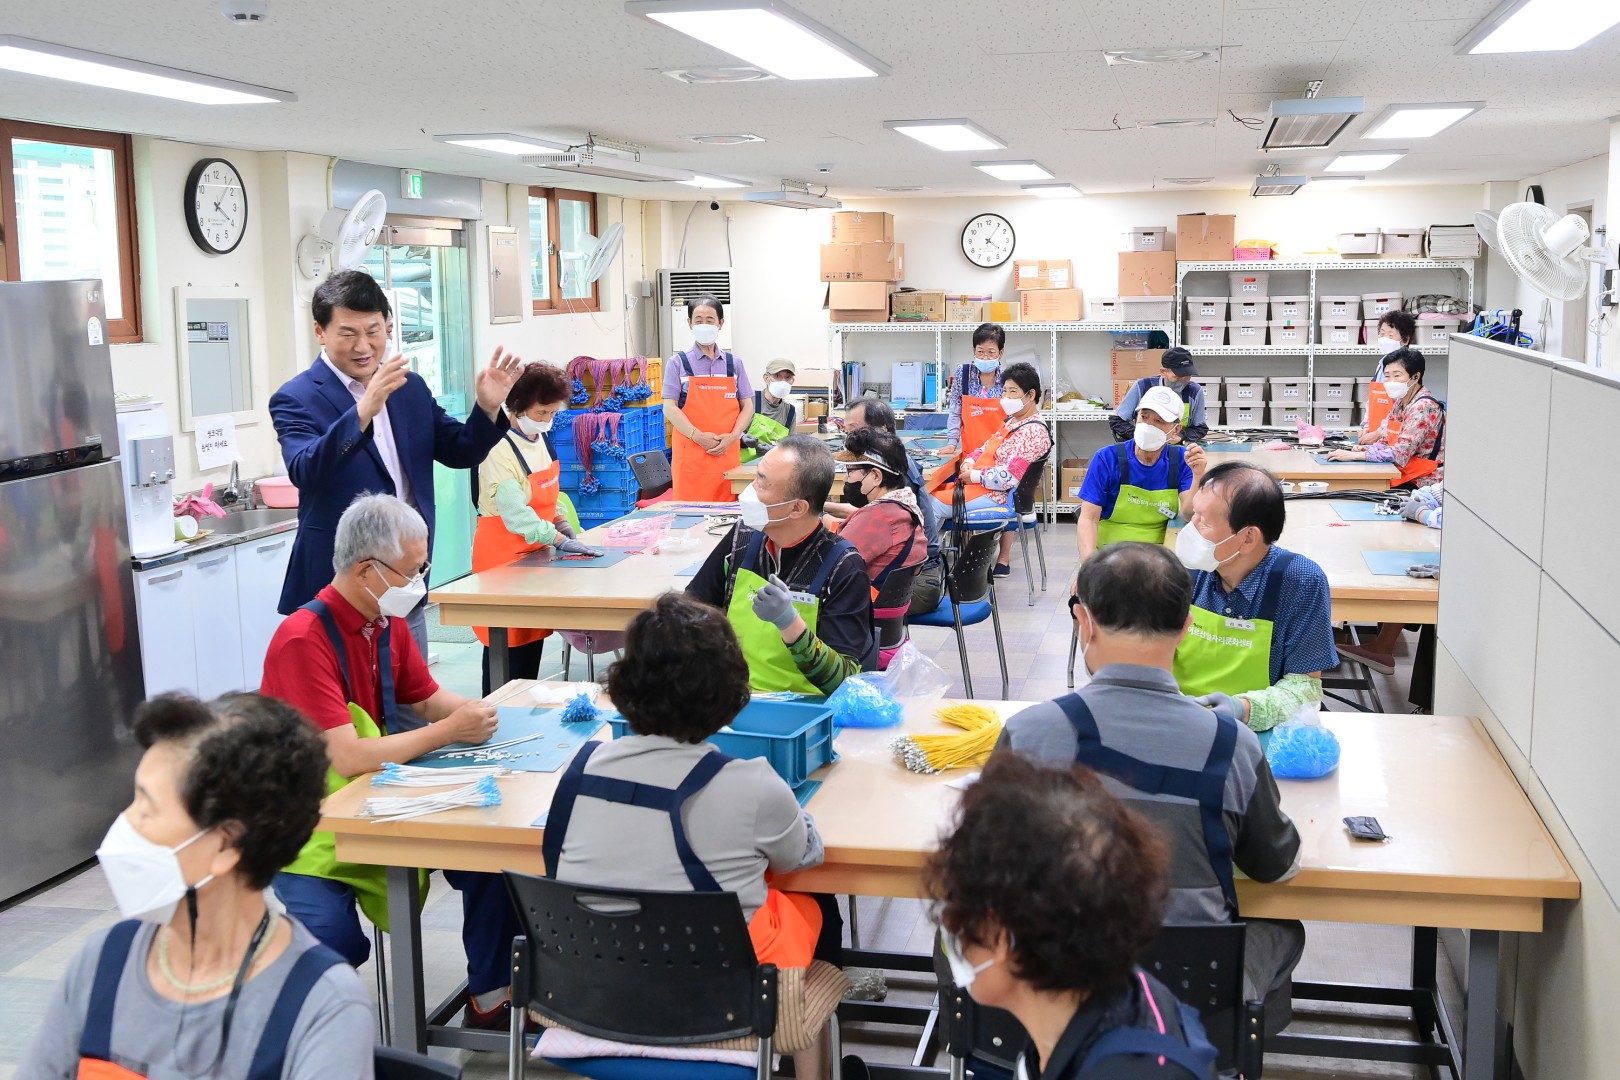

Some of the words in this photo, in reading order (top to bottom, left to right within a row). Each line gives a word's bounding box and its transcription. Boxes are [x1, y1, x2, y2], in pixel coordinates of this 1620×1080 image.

[204, 174, 210, 182] 11
[213, 170, 219, 179] 12
[224, 176, 227, 184] 1
[199, 185, 204, 194] 10
[230, 188, 234, 196] 2
[197, 201, 200, 210] 9
[233, 203, 237, 212] 3
[200, 217, 204, 226] 8
[231, 219, 235, 227] 4
[207, 229, 211, 238] 7
[216, 233, 220, 242] 6
[225, 230, 229, 239] 5
[1187, 626, 1252, 649] 어르신일자리문화센터
